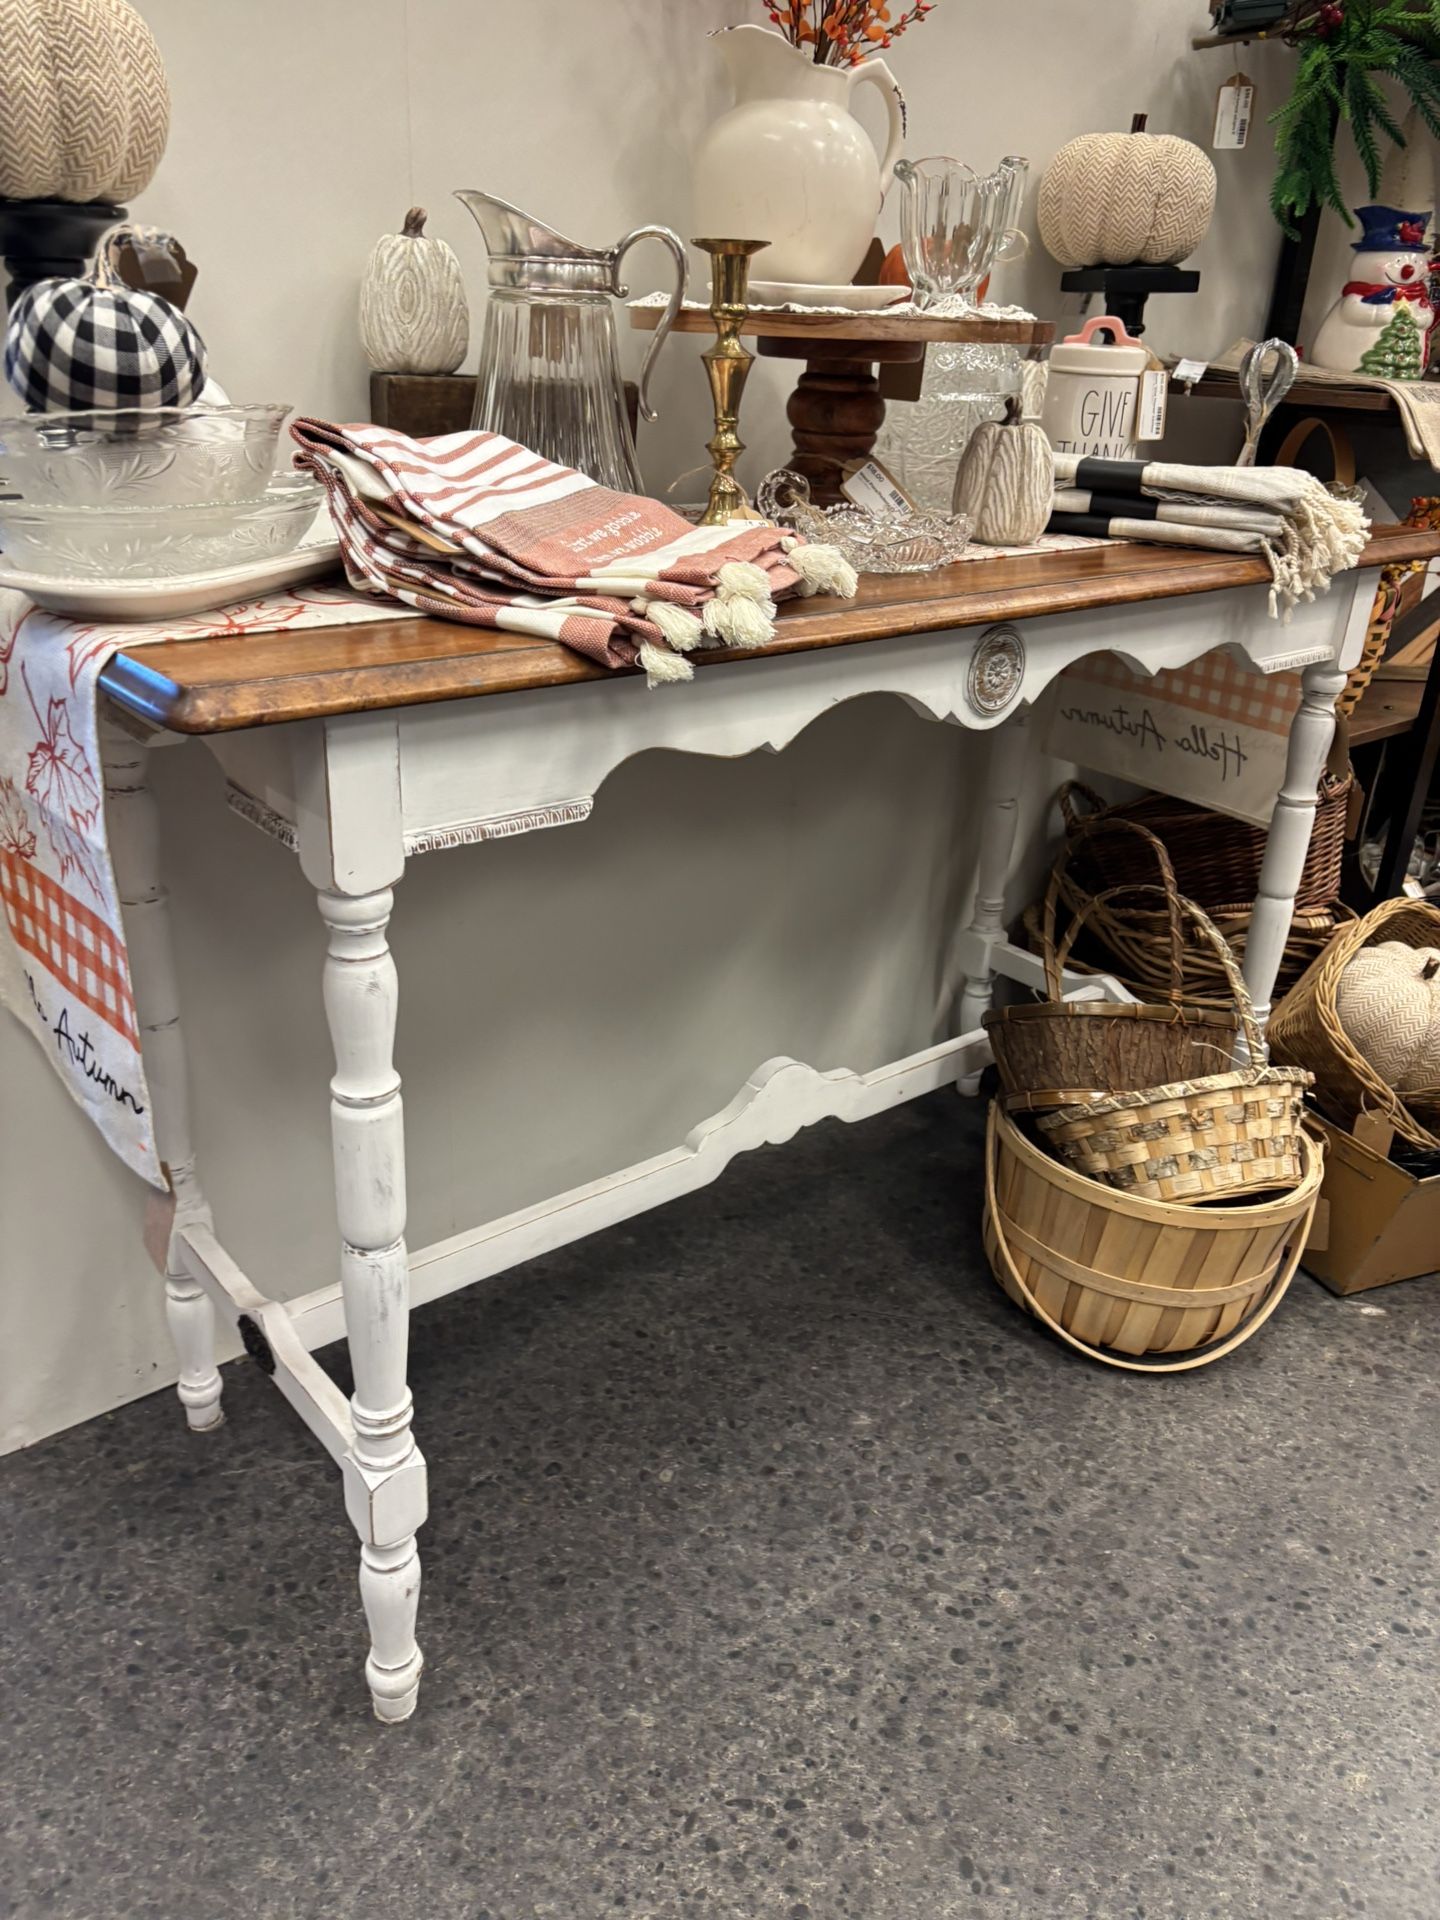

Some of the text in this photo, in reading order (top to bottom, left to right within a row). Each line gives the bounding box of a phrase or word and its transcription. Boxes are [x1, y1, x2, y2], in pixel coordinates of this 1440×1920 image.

[1081, 390, 1131, 438] GIVE
[603, 511, 642, 537] gobble
[624, 525, 663, 551] wobble
[53, 1007, 144, 1115] Autumn
